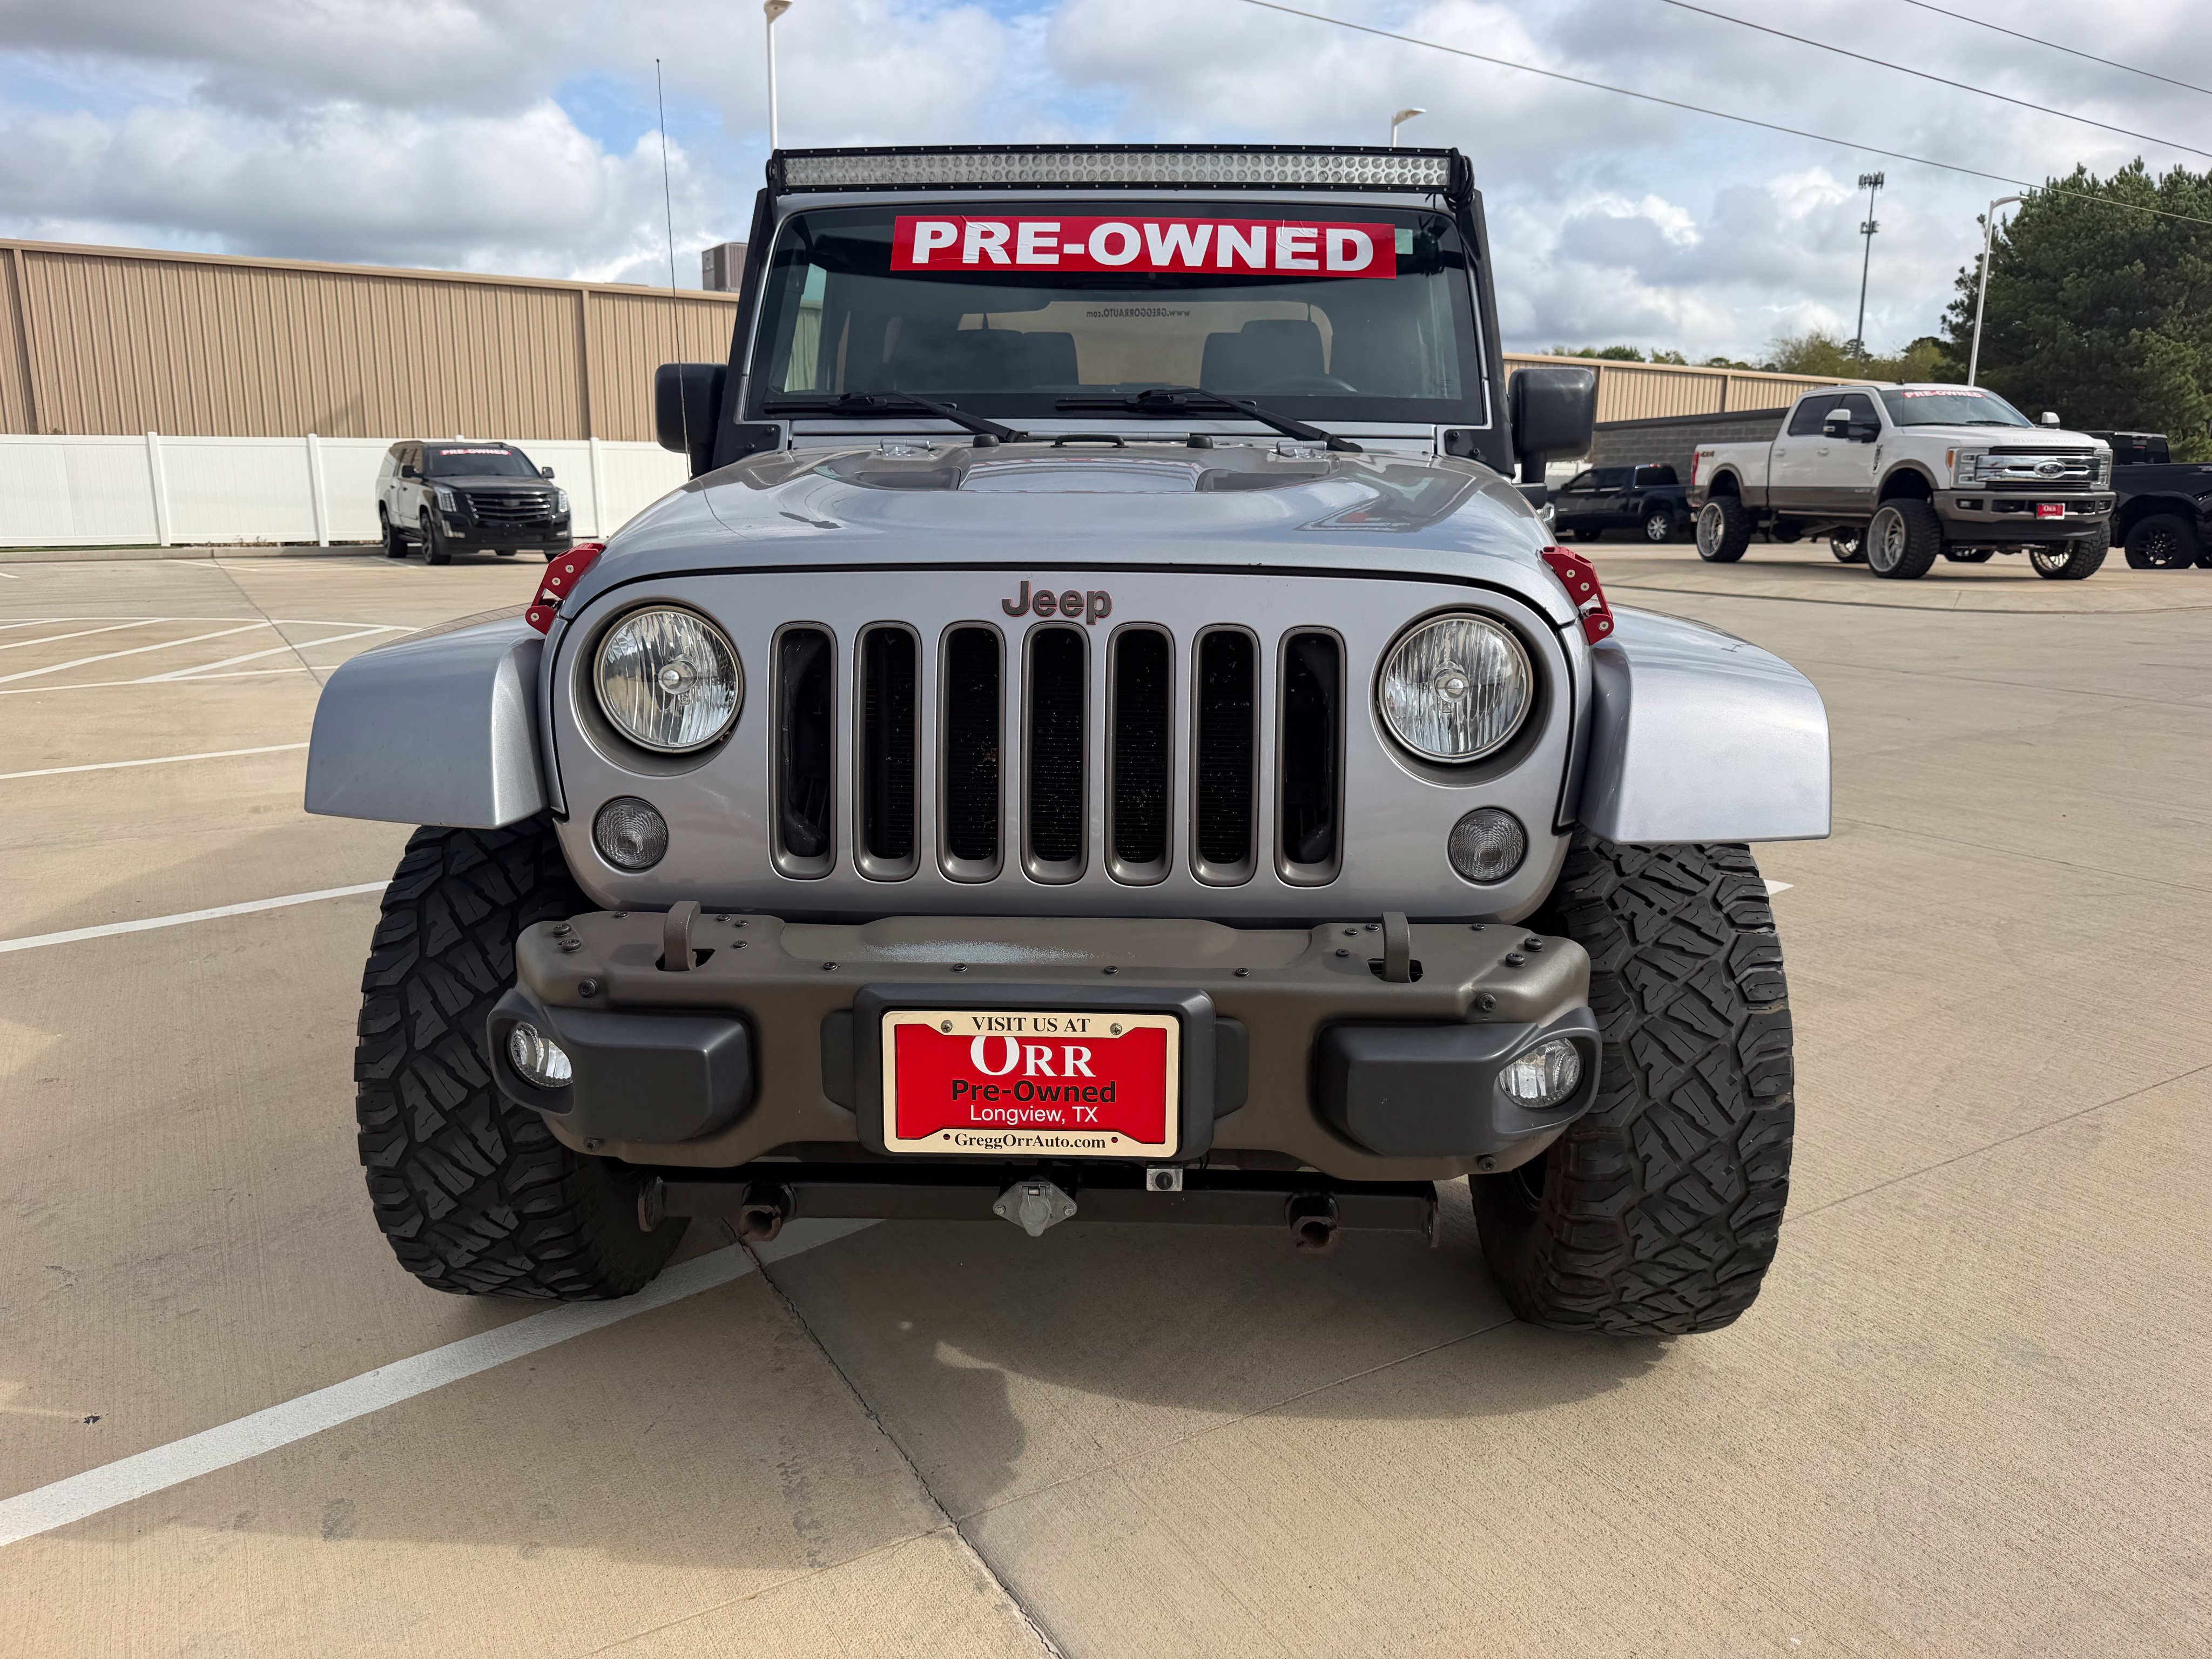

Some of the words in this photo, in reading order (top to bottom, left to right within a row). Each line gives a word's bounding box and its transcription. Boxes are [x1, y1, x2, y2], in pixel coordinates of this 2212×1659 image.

[912, 221, 1373, 272] PRE-OWNED
[1002, 581, 1114, 625] Jeep
[972, 1017, 1026, 1031] VISIT
[1033, 1018, 1057, 1032] US
[1063, 1019, 1090, 1032] AT
[970, 1036, 1096, 1077] ORR
[952, 1080, 1116, 1103] Pre-Owned
[971, 1105, 1065, 1125] Longview,
[1072, 1106, 1098, 1123] TX
[955, 1133, 1105, 1149] GreggOrrAuto.com
